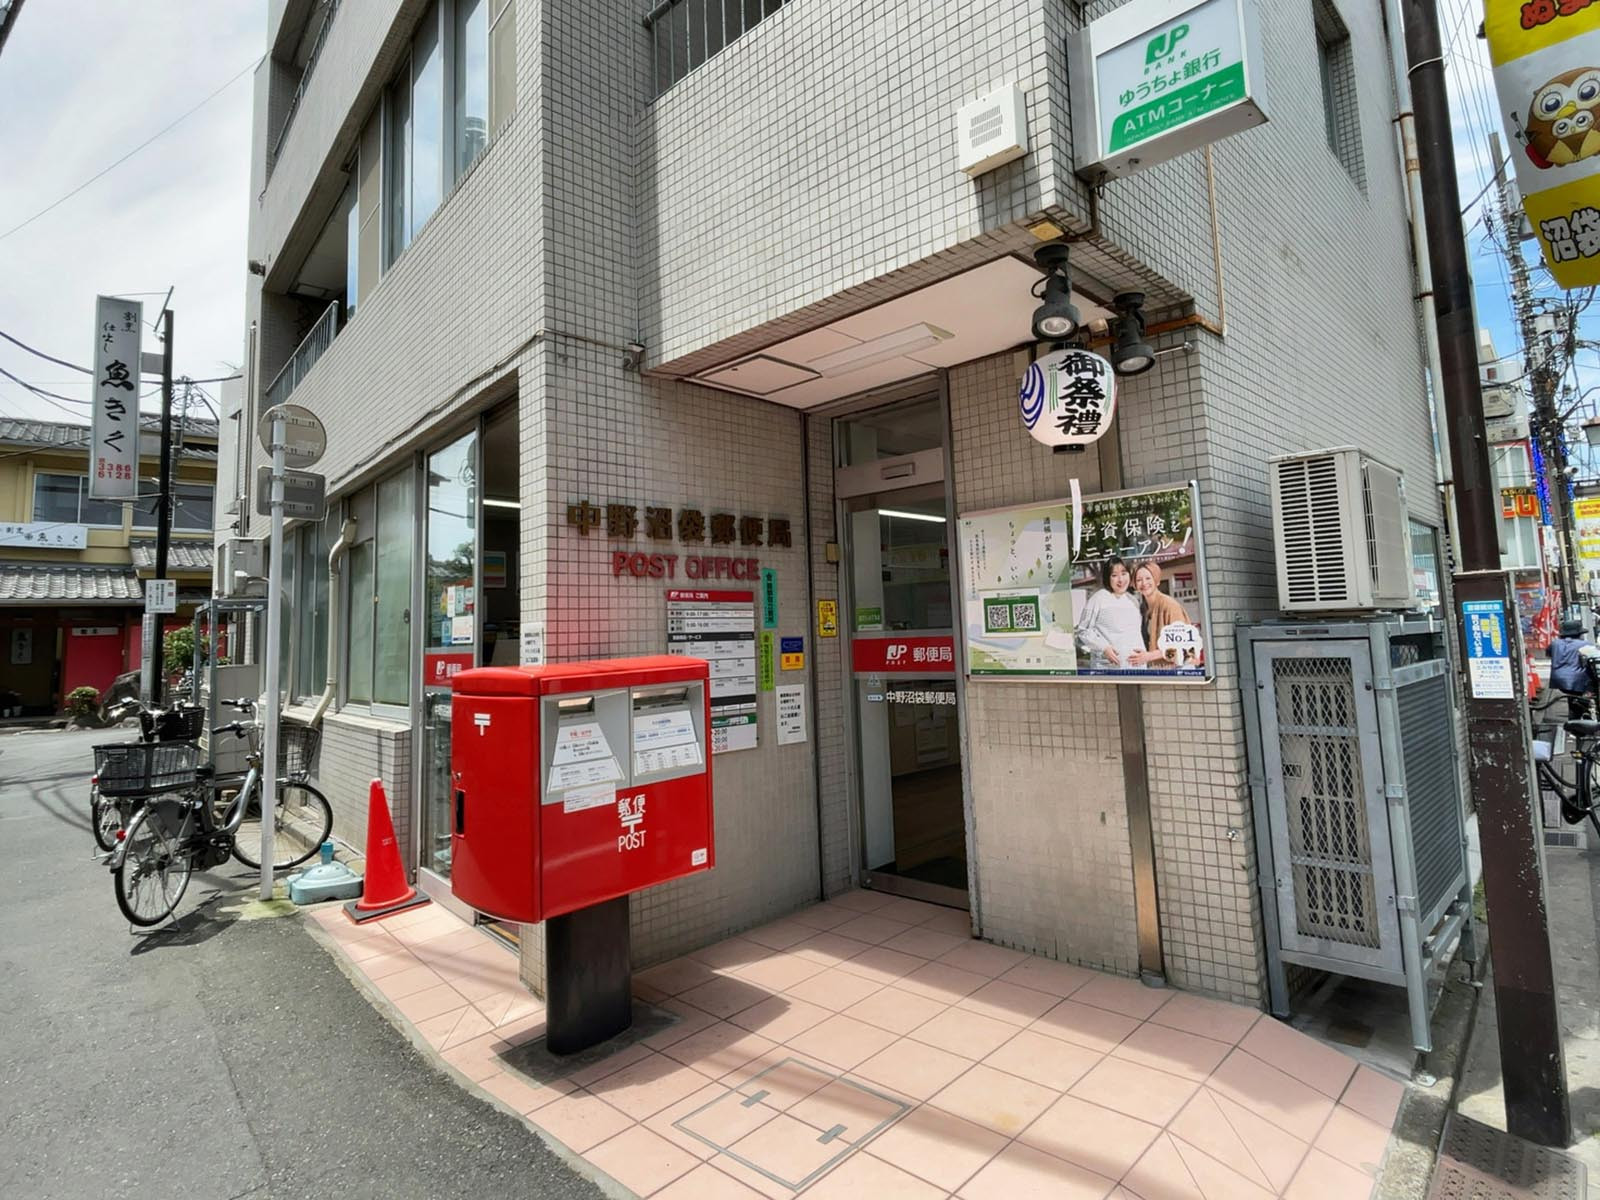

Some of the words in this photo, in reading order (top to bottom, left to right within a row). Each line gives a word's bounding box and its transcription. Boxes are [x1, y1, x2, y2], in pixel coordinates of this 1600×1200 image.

[1143, 49, 1188, 76] BANK
[1119, 48, 1222, 108] ゆうちょ銀行
[1123, 79, 1235, 134] ATMコーナー
[101, 359, 135, 453] 魚きく
[567, 500, 793, 549] 中野沼袋郵便局
[1081, 515, 1181, 542] 学資保険を
[612, 551, 679, 580] POST
[684, 555, 761, 582] OFFICE
[1165, 630, 1195, 642] No.1
[913, 646, 953, 663] 郵便局
[886, 690, 957, 705] 中野沼袋郵便局
[618, 794, 646, 818] 郵便
[618, 830, 647, 853] POST
